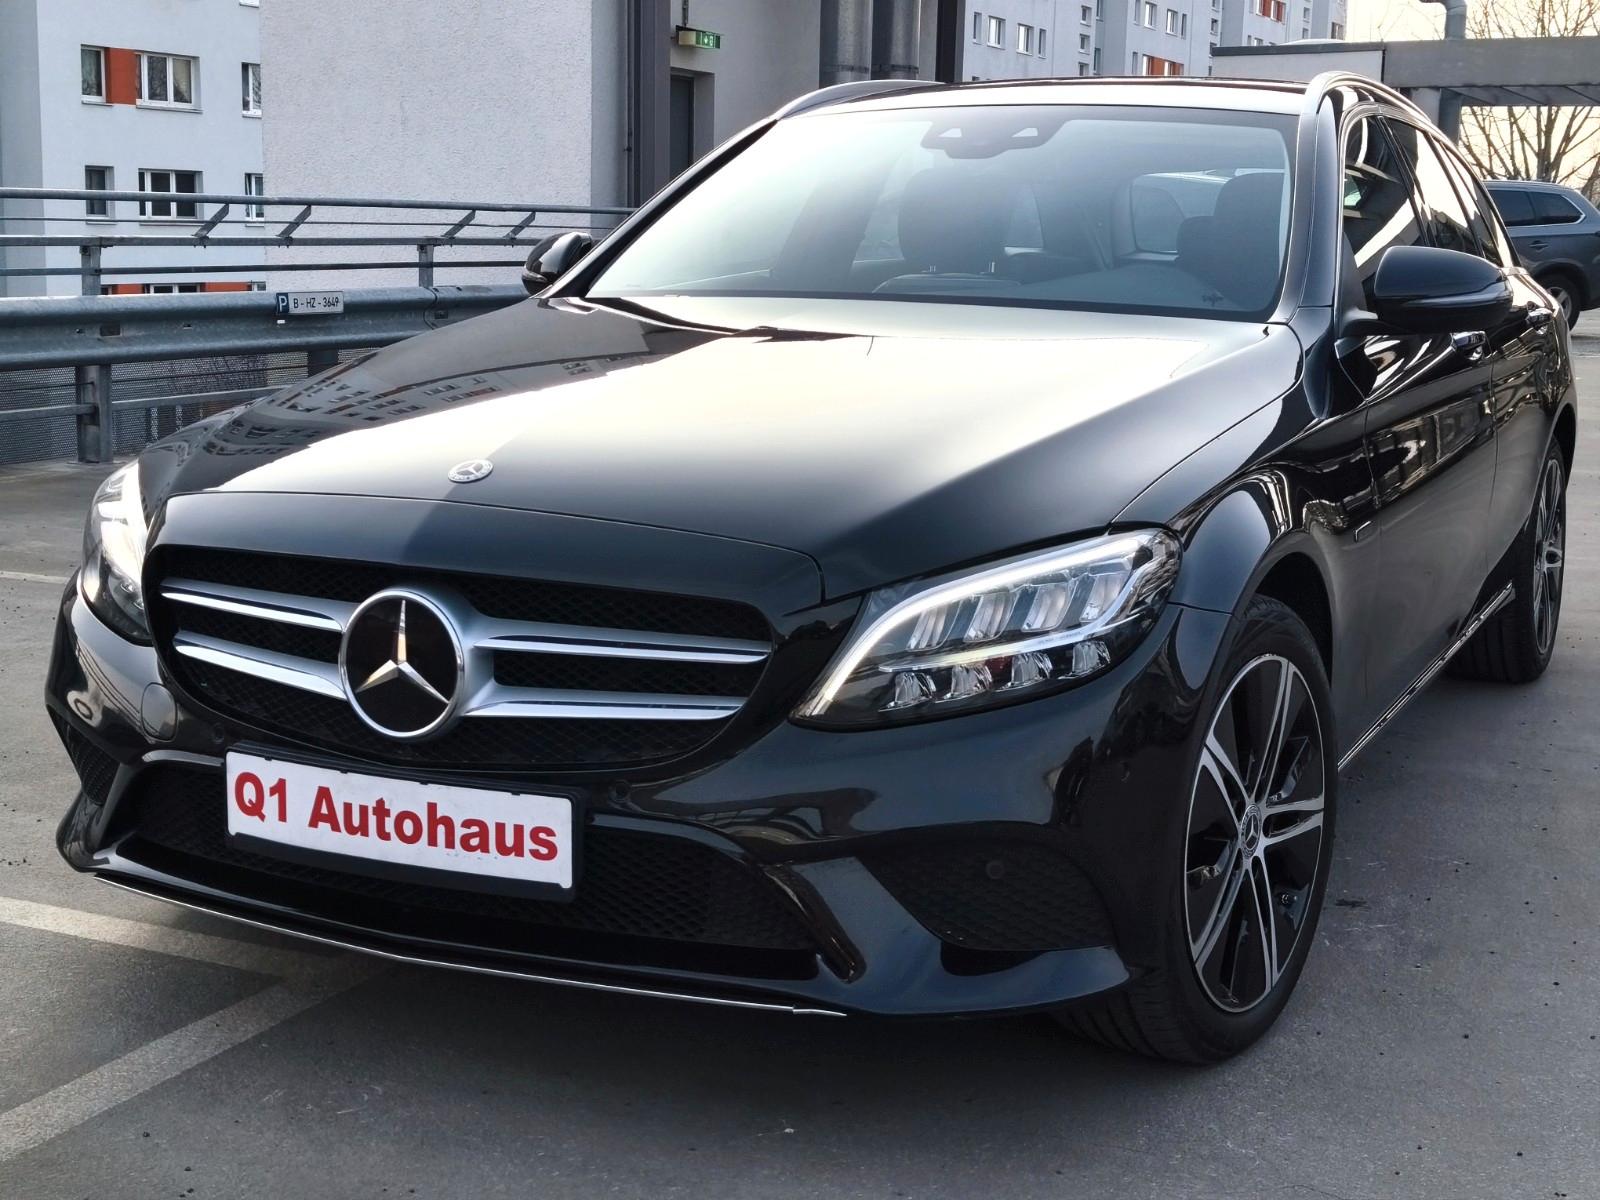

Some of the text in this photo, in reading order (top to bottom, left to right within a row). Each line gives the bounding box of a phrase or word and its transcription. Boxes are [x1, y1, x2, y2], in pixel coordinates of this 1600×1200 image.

[278, 295, 288, 312] P
[234, 771, 559, 862] Q1 Autohaus
